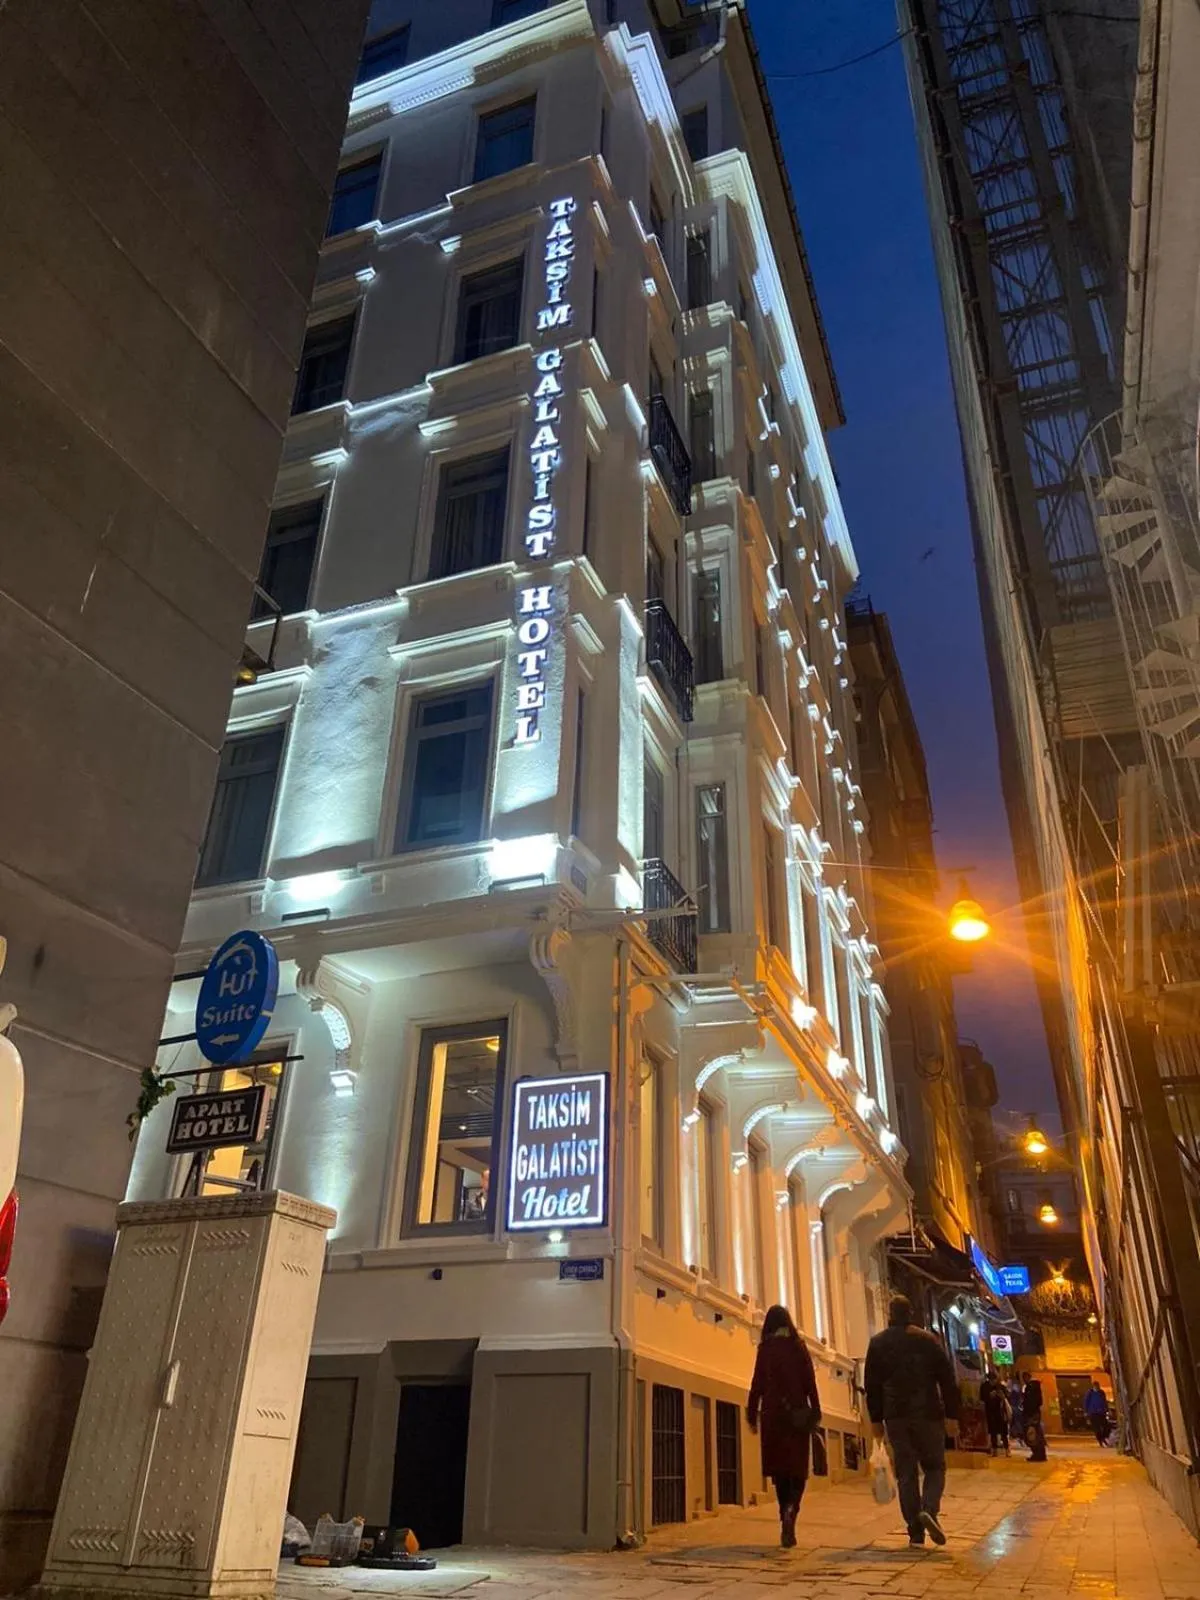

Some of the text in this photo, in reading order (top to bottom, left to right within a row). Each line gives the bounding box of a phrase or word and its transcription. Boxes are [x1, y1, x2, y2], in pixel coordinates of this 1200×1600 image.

[525, 348, 563, 556] GALATİST
[513, 585, 553, 744] HOTEL
[200, 1003, 257, 1028] Suite
[183, 1099, 246, 1120] APART
[527, 1084, 591, 1130] TAKSİM
[175, 1115, 250, 1140] HOTEL
[516, 1132, 599, 1181] GALATİST
[521, 1184, 592, 1219] Hotel
